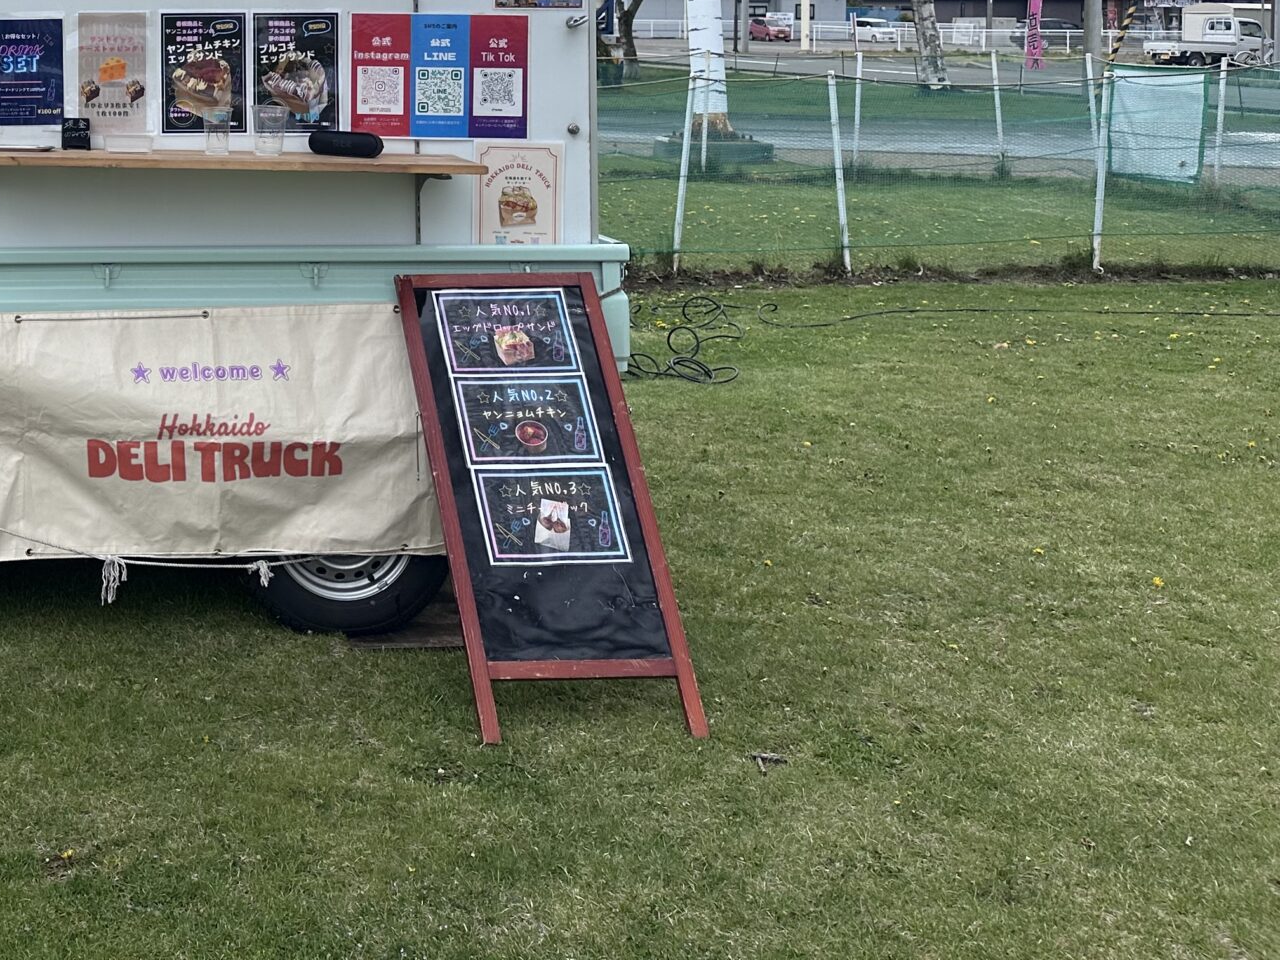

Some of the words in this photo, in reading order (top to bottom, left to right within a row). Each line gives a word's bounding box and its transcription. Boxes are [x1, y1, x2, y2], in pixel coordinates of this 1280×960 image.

[167, 39, 240, 54] ヤンニョムチキン
[372, 37, 392, 46] 公式
[430, 38, 450, 47] 公式
[488, 38, 508, 48] 公式
[168, 51, 222, 64] エッグサンド
[260, 50, 315, 64] エッグサンド
[424, 52, 456, 61] LINE
[481, 52, 495, 62] Tik
[498, 52, 516, 63] Tok
[0, 56, 39, 73] SET
[485, 163, 515, 188] HOKKAIDO
[516, 163, 532, 171] DELI
[535, 169, 551, 189] TRUCK
[453, 321, 557, 333] エッグドロップサンド
[160, 362, 262, 382] welcome
[482, 407, 567, 419] ヤンニョムチキン
[157, 413, 271, 440] Hokkaido
[87, 439, 187, 483] DELI
[194, 440, 343, 482] TRUCK
